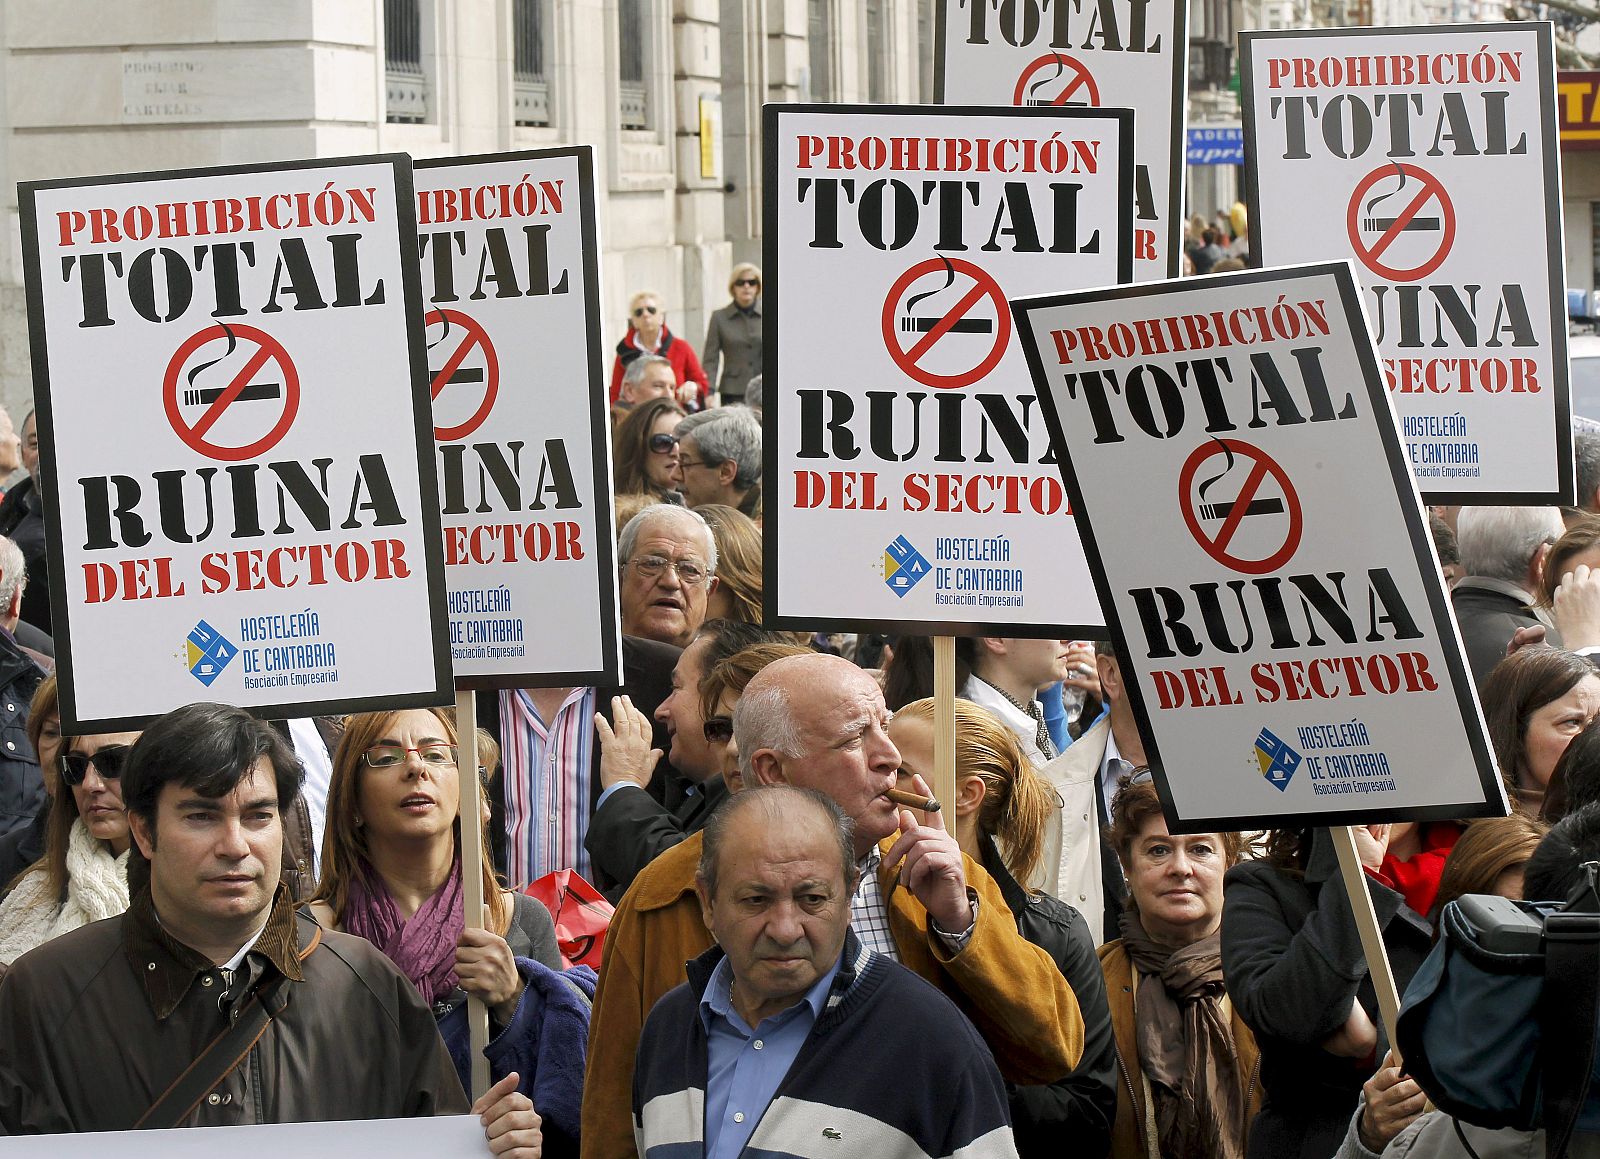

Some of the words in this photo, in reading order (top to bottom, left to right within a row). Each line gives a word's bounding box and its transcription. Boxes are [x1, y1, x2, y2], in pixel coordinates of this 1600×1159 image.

[959, 0, 1161, 53] TOTAL
[1268, 45, 1521, 89] PROHIBICIÓN
[1270, 91, 1527, 160] TOTAL
[797, 131, 1101, 175] PROHIBICIÓN
[57, 181, 376, 247] PROHIBICIÓN
[418, 174, 563, 225] IBICIÓN
[797, 177, 1100, 254] TOTAL
[61, 233, 386, 328] TOTAL
[418, 223, 569, 304] TAL
[1051, 294, 1329, 365] PROHIBICIÓN
[1063, 346, 1358, 445] TOTAL
[795, 389, 1058, 465] RUIN
[1403, 411, 1467, 437] HOSTELERÍA
[1421, 443, 1479, 464] CANTABRIA
[1441, 466, 1481, 479] Empresarial
[438, 438, 583, 515] INA
[794, 470, 888, 511] DEL
[903, 473, 1074, 516] SECTO
[77, 453, 408, 551] RUINA
[444, 521, 585, 565] ECTOR
[936, 534, 1010, 561] HOSTELERÍA
[81, 557, 186, 604] DEL
[200, 538, 411, 594] SECTOR
[936, 567, 952, 590] DE
[956, 568, 1023, 592] CANTABRIA
[448, 584, 511, 614] HOSTELERÍA
[935, 593, 977, 605] Asociación
[978, 594, 1024, 608] Empresarial
[1127, 567, 1425, 659] RUINA
[240, 607, 320, 642] HOSTELERÍA
[450, 621, 464, 644] DE
[467, 619, 523, 643] CANTABRIA
[243, 649, 261, 673] DE
[264, 642, 336, 671] CANTABRIA
[487, 645, 525, 660] Empresarial
[244, 674, 289, 689] Asociación
[290, 669, 339, 687] Empresarial
[1151, 666, 1243, 709] DEL
[1250, 652, 1438, 703] SECTOR
[1297, 717, 1370, 750] HOSTELERÍA
[1306, 756, 1326, 780] DE
[1324, 752, 1391, 779] CANTABRIA
[1312, 781, 1353, 796] Asociación
[1352, 778, 1397, 794] Empresarial
